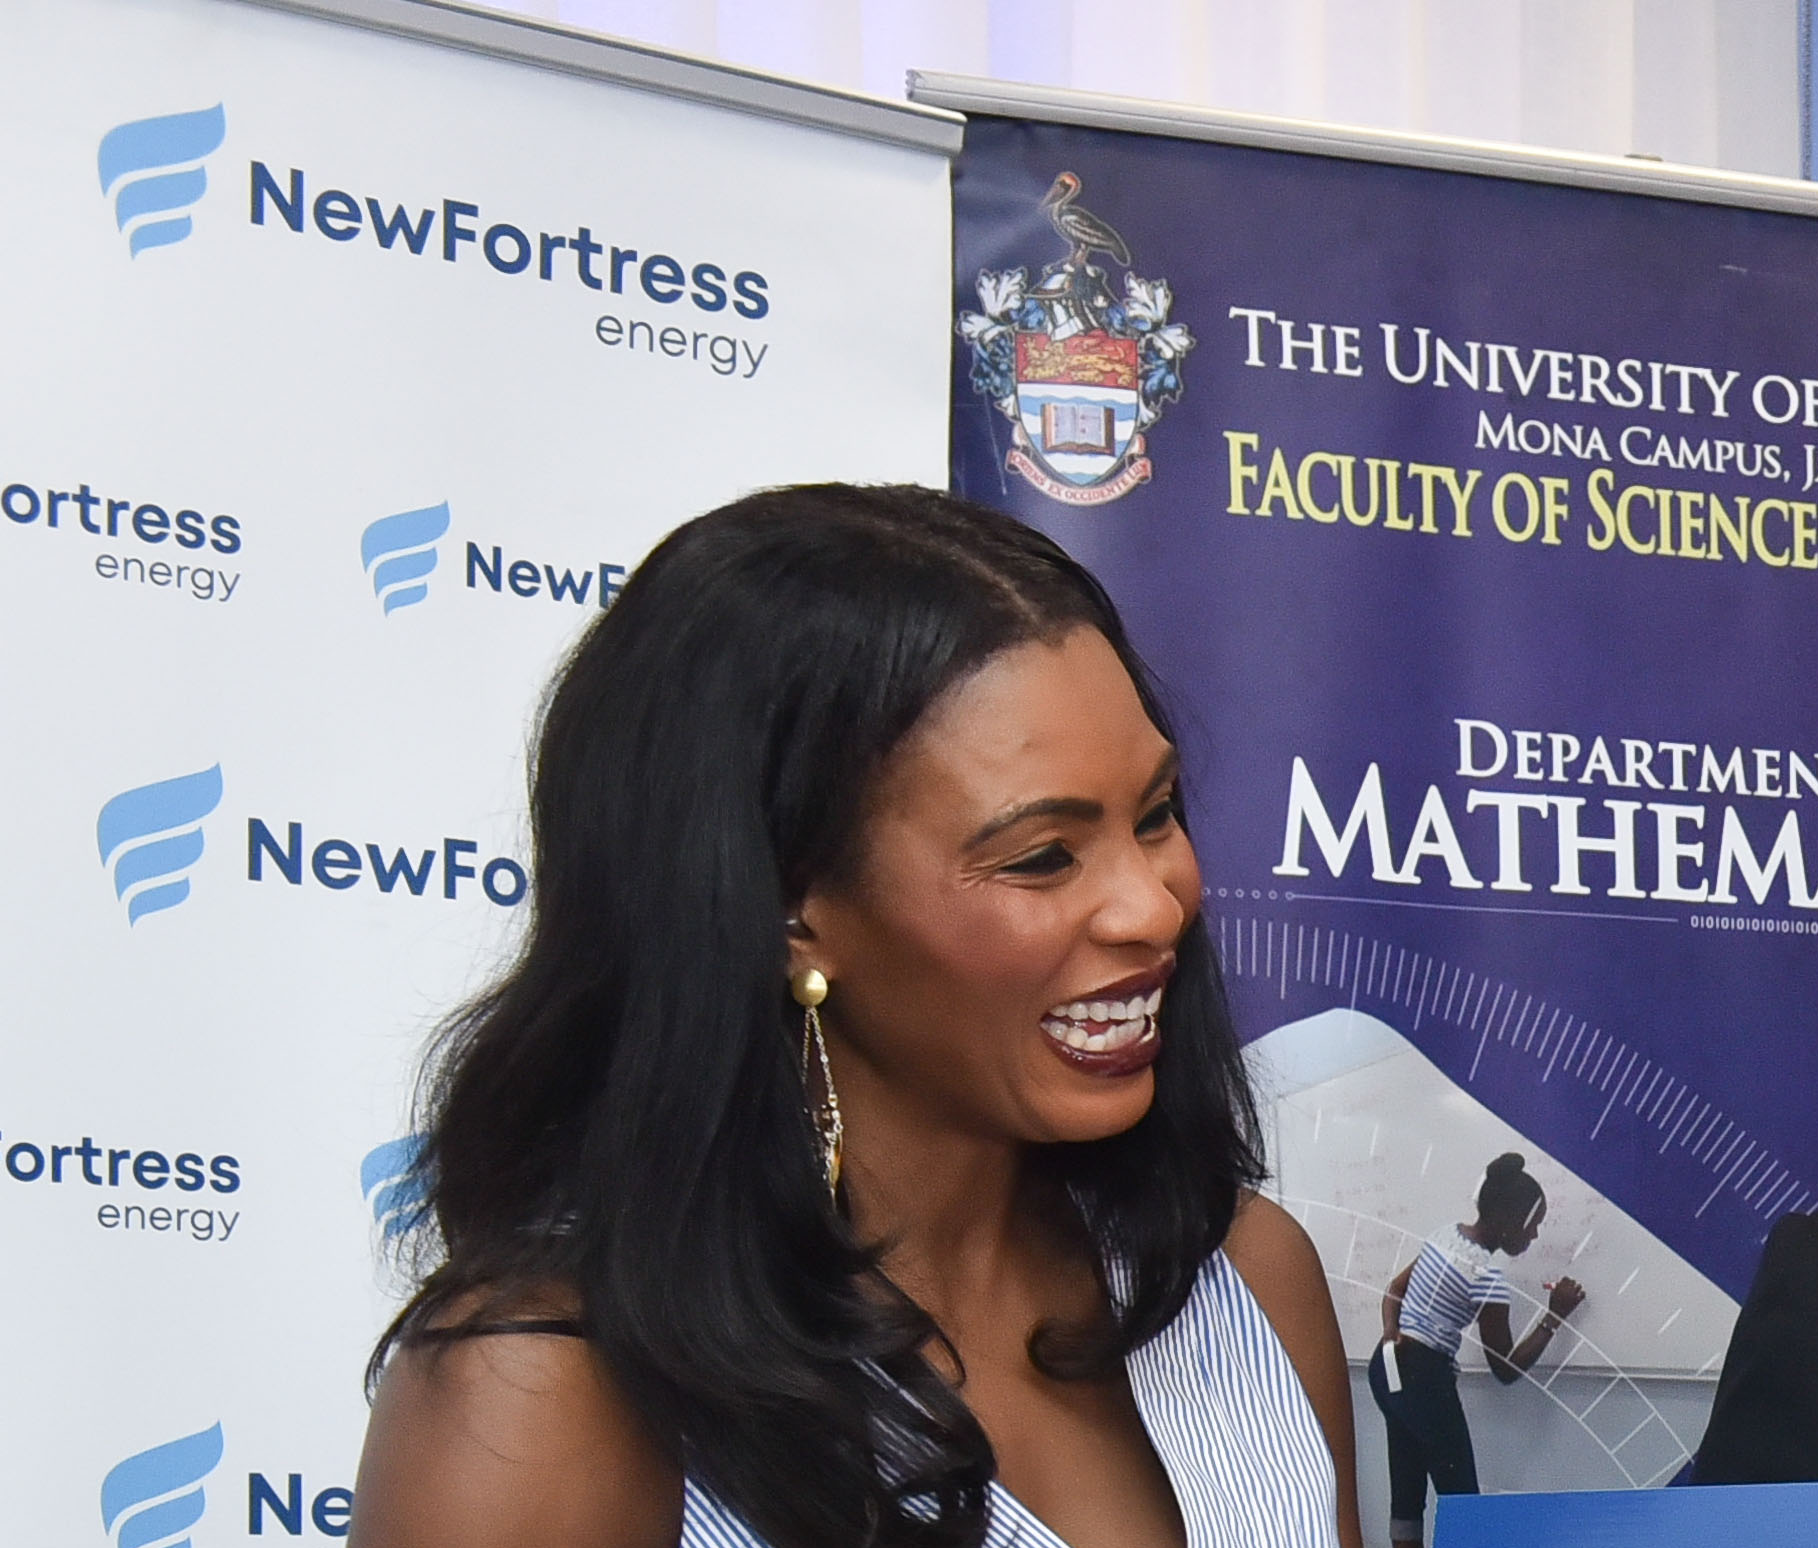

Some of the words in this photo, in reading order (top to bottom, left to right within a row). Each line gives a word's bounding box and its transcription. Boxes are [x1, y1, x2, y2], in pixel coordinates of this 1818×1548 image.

[249, 160, 770, 320] NewFortress
[595, 312, 769, 379] energy
[1229, 307, 1363, 377] THE
[1380, 323, 1739, 418] UNIVERSITY
[1475, 411, 1611, 463] MONA
[1620, 426, 1790, 483] CAMPUS,
[1223, 431, 1482, 539] FACULTY
[1493, 472, 1569, 545] OF
[1587, 466, 1818, 570] SCIENCE
[95, 553, 241, 602] energy
[0, 1130, 241, 1193] ortress
[97, 1203, 240, 1242] energy
